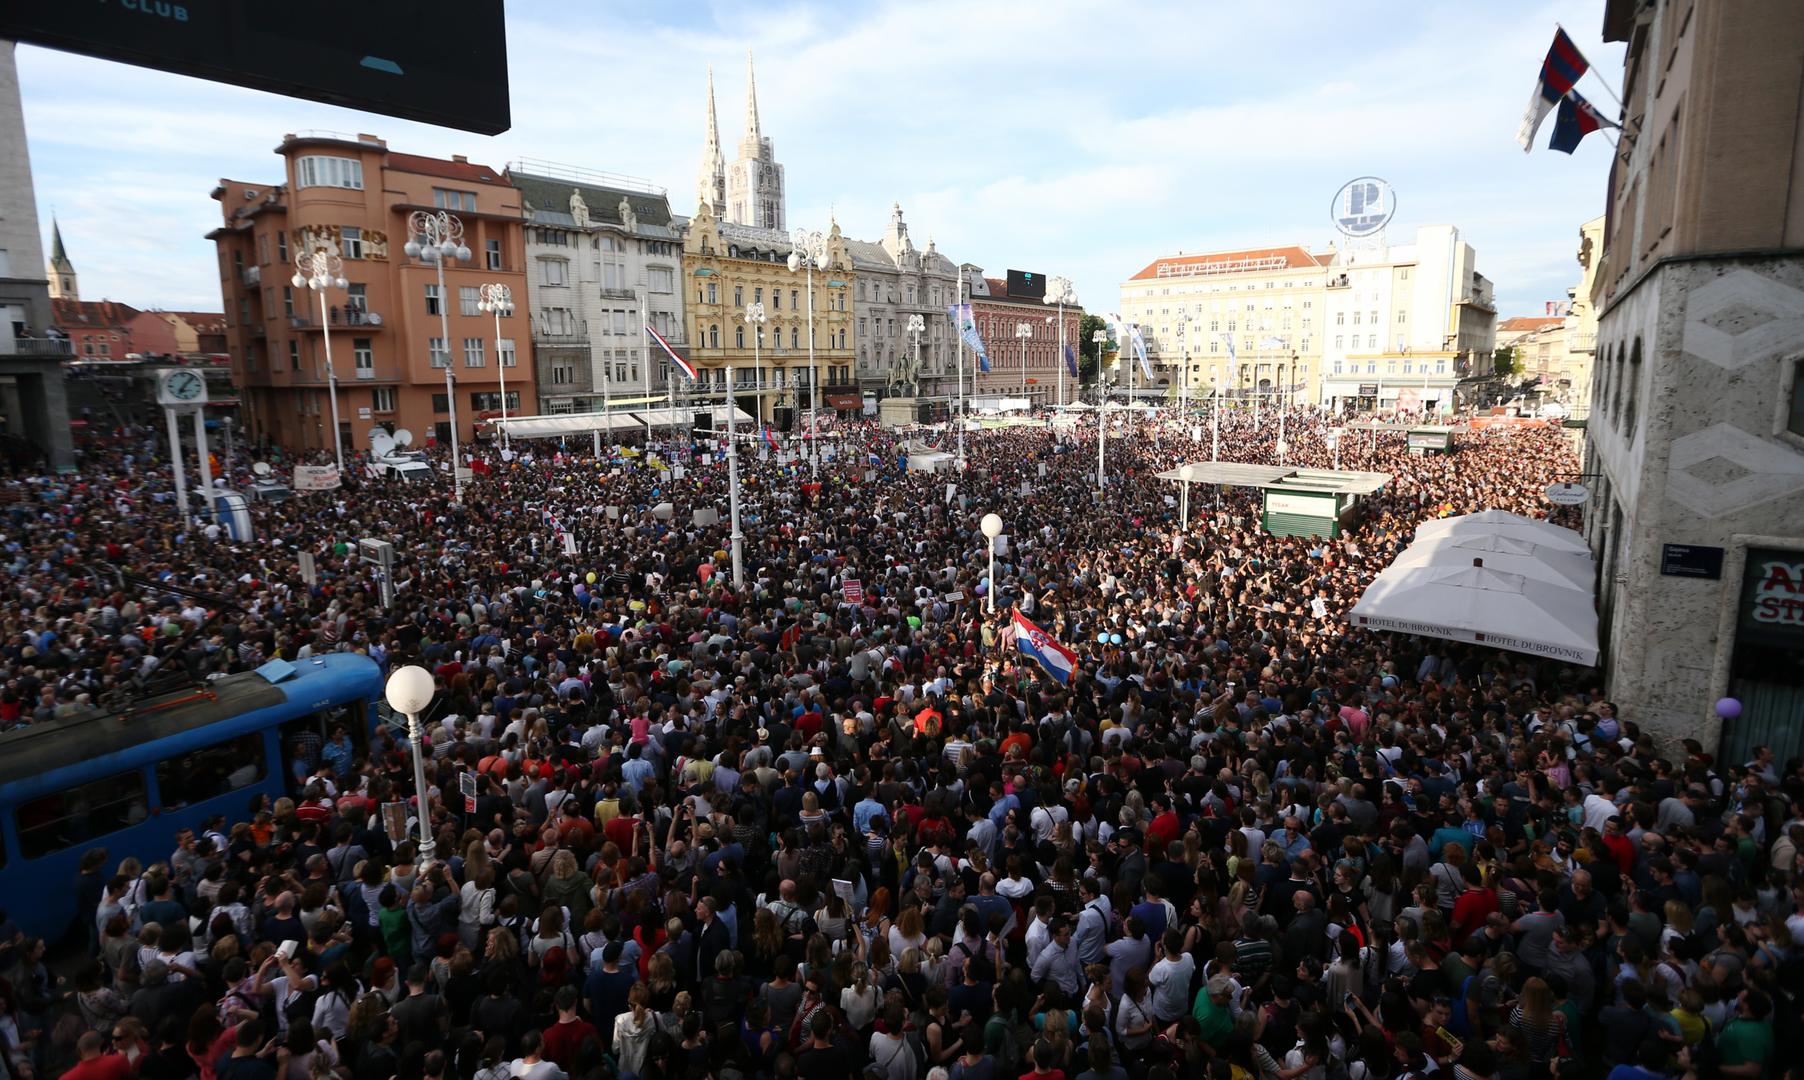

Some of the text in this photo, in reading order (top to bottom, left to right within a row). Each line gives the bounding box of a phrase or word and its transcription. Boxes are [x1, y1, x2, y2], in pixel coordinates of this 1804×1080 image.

[121, 0, 189, 22] CLUB
[1368, 617, 1453, 637] HOTEL DUBROVNIK
[1486, 635, 1584, 661] HOTEL DUBROVNIK
